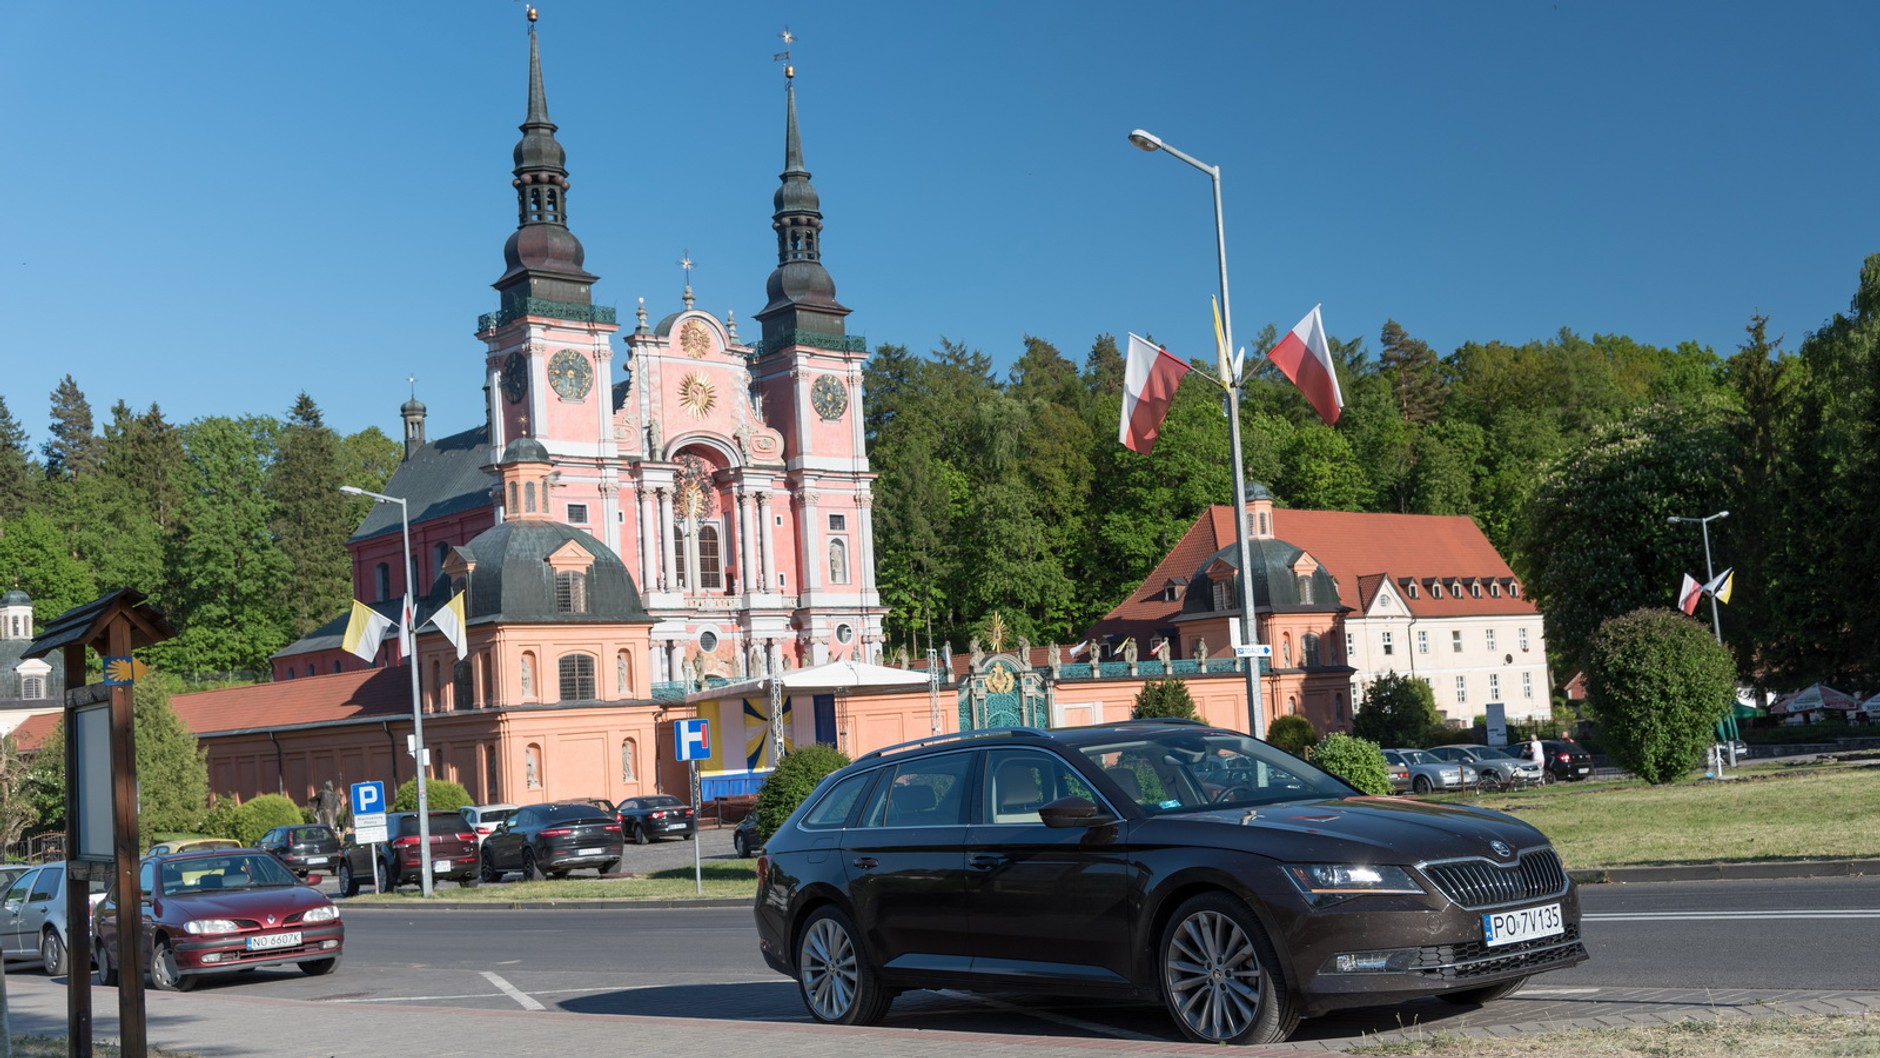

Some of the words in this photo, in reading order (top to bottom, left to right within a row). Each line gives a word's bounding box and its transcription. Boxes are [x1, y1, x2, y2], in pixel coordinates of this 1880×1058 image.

[359, 785, 378, 811] P
[1494, 914, 1516, 938] PO
[1520, 906, 1559, 934] 7V135
[253, 936, 267, 946] NO
[270, 933, 300, 945] 6607K
